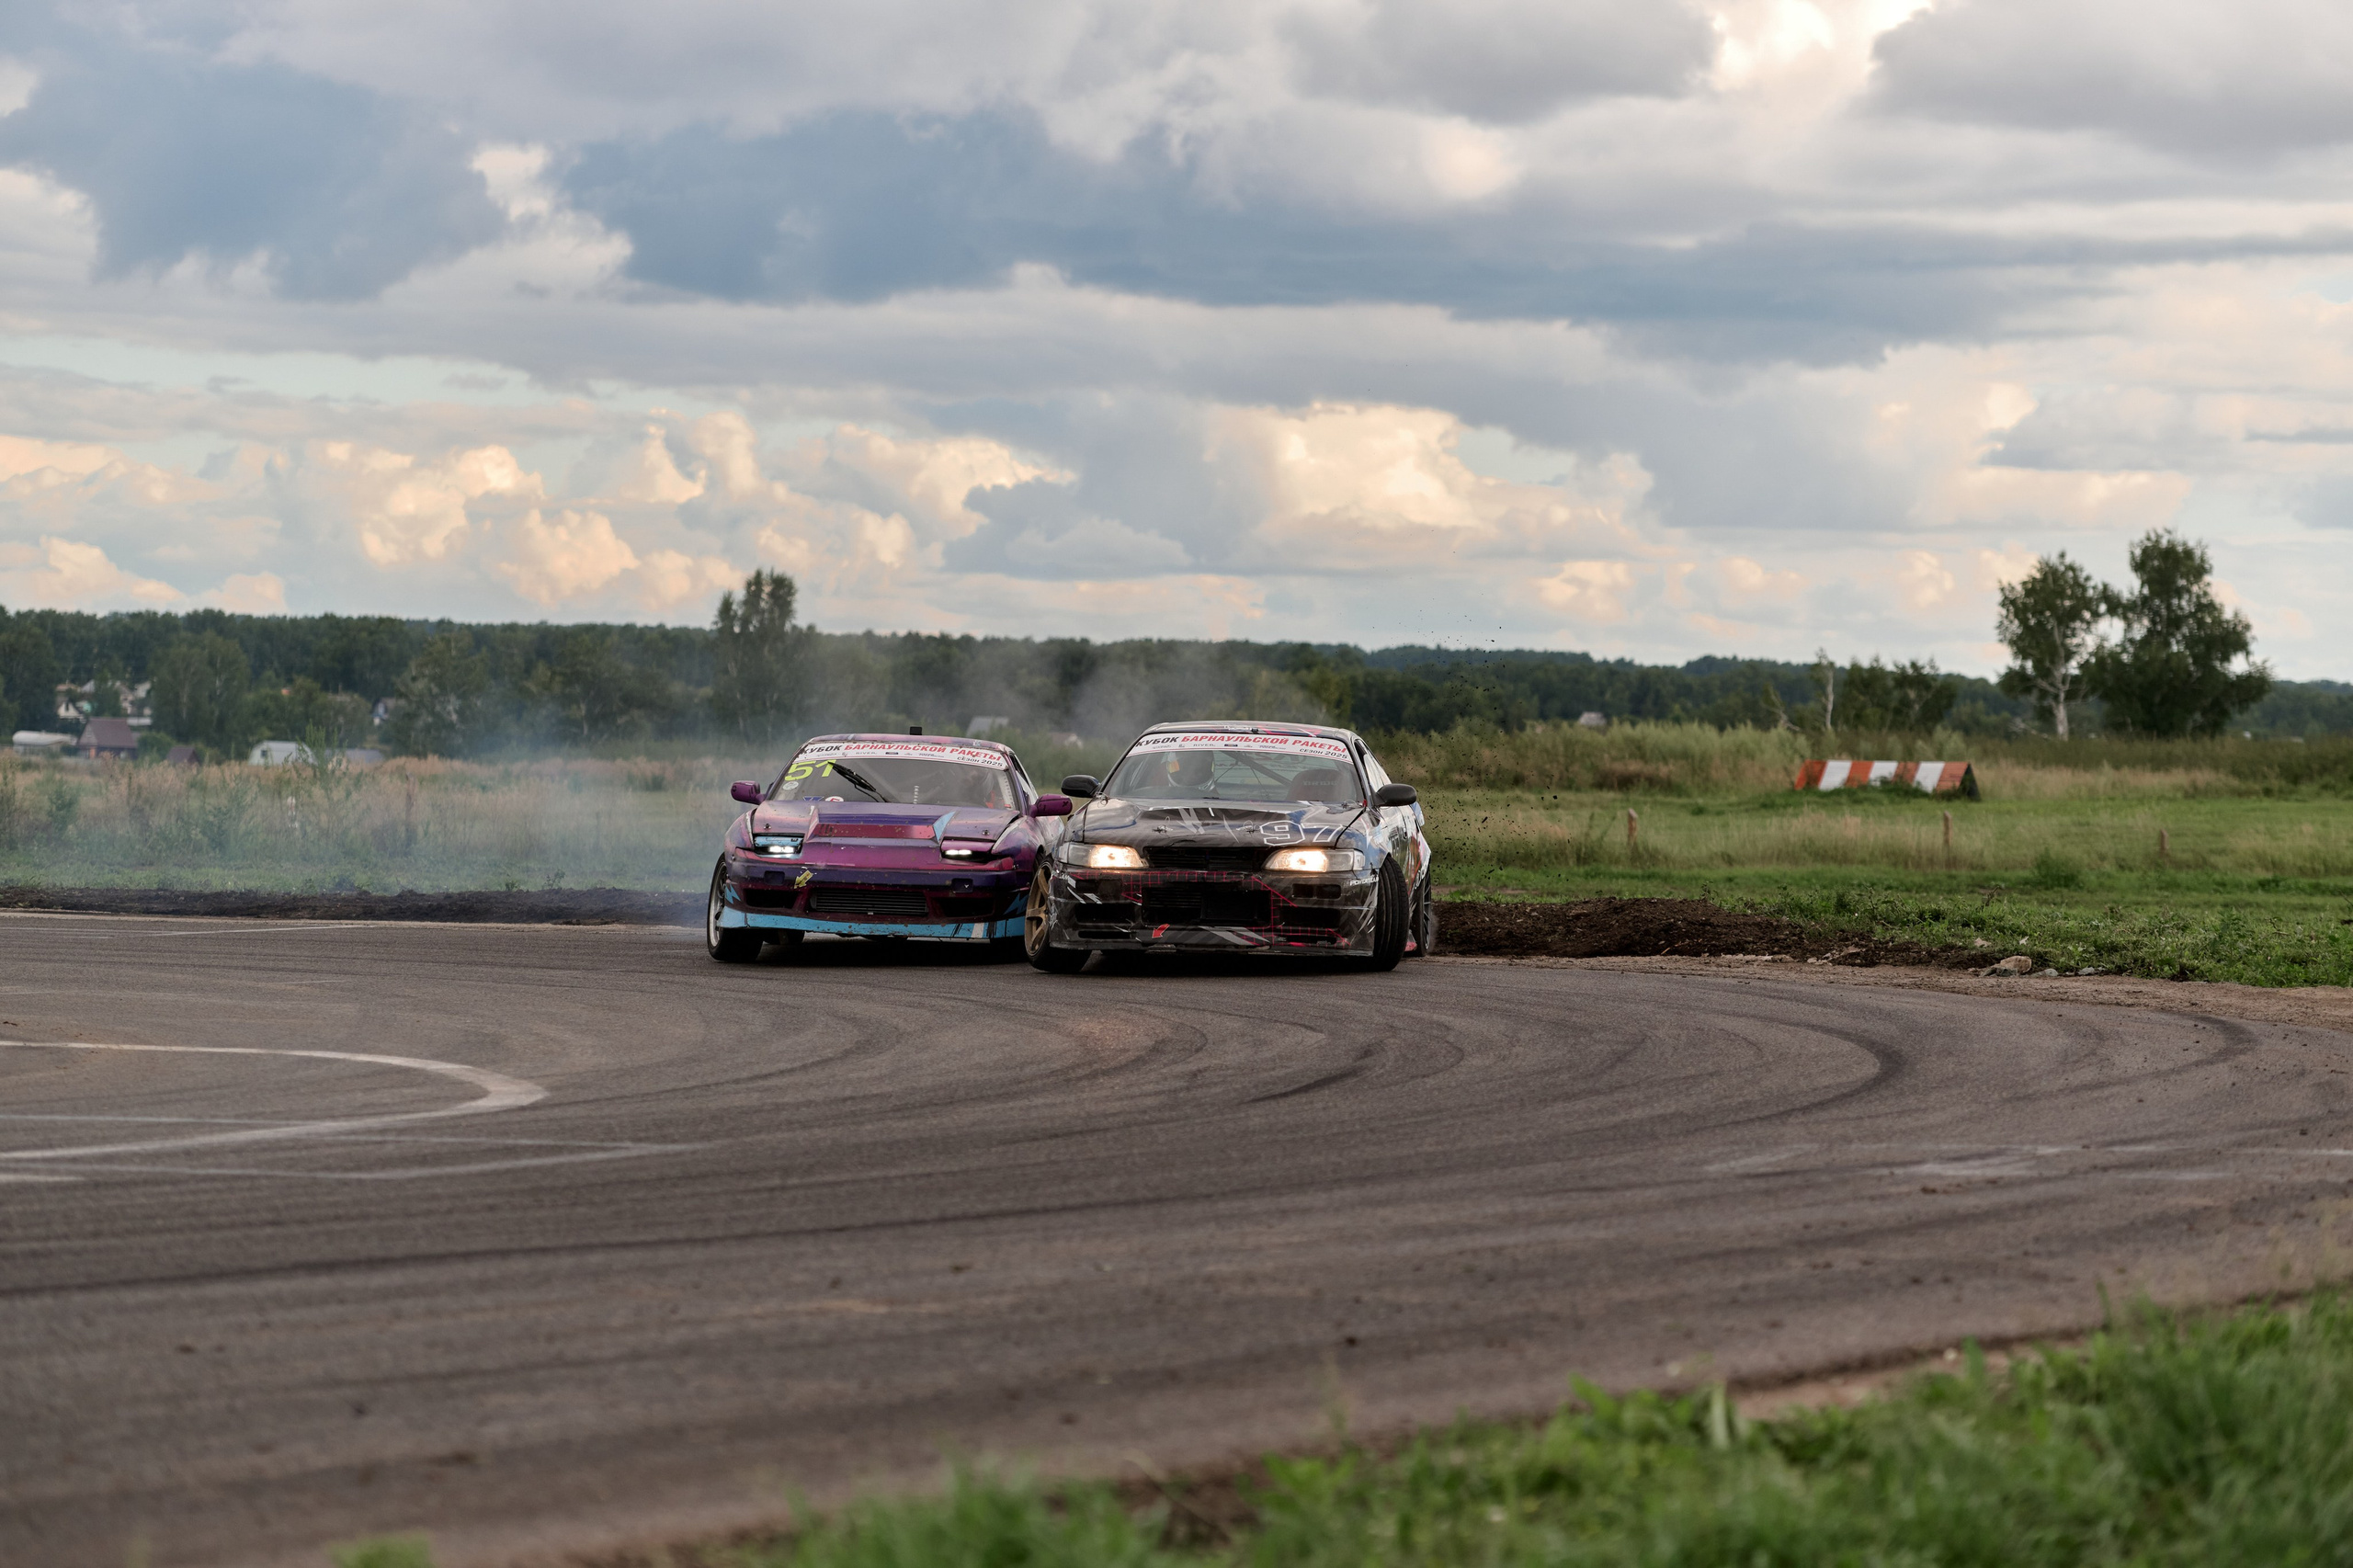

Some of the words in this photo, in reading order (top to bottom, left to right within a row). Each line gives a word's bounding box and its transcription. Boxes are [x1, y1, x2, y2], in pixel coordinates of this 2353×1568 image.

[845, 744, 947, 753] БАРНАУЛЬСКОЙ
[949, 747, 1002, 761] РАКЕТЫ
[1135, 736, 1179, 747] КУБОК
[1181, 735, 1289, 744] БАРНАУЛЬСКОЙ
[1291, 739, 1347, 753] РАКЕТЫ
[1324, 750, 1348, 759] 2025
[785, 759, 836, 781] 51
[1260, 820, 1343, 846] 97
